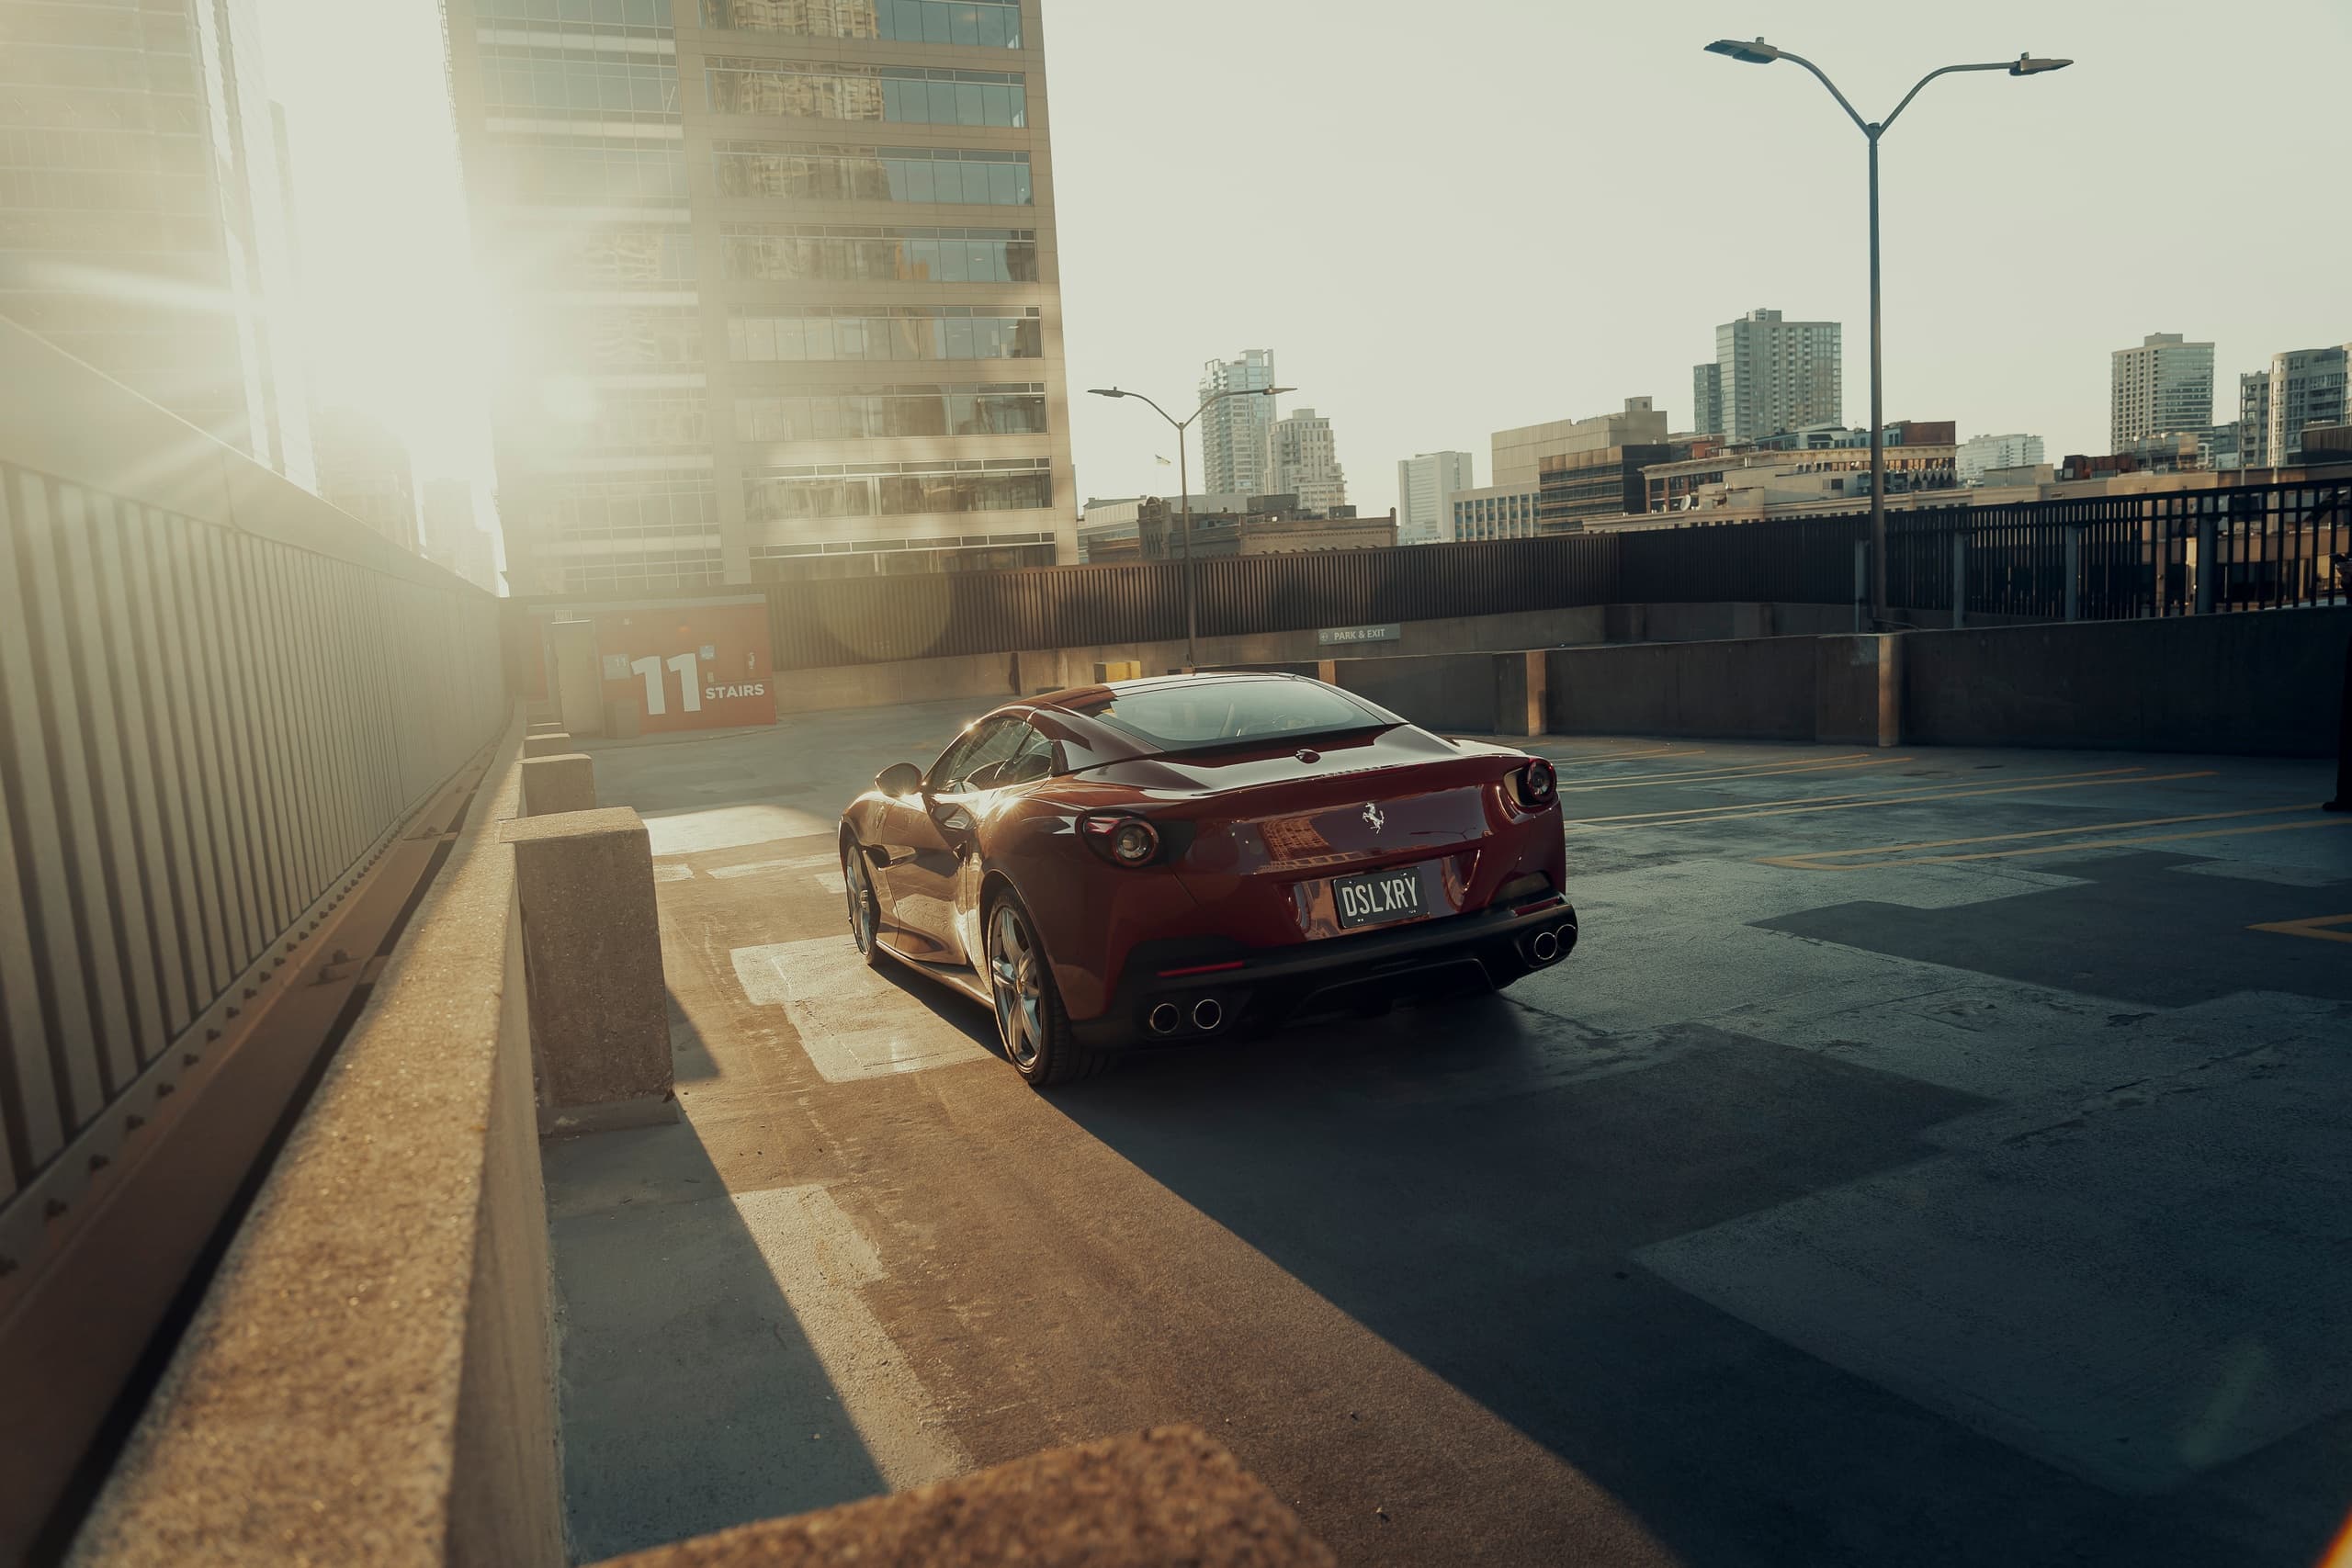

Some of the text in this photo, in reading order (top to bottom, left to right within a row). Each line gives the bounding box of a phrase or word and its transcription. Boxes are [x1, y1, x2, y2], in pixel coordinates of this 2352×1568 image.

[1334, 628, 1385, 640] PARK & EXIT
[631, 653, 701, 715] 11
[706, 683, 764, 699] STAIRS
[1341, 876, 1419, 917] DSLXRY
